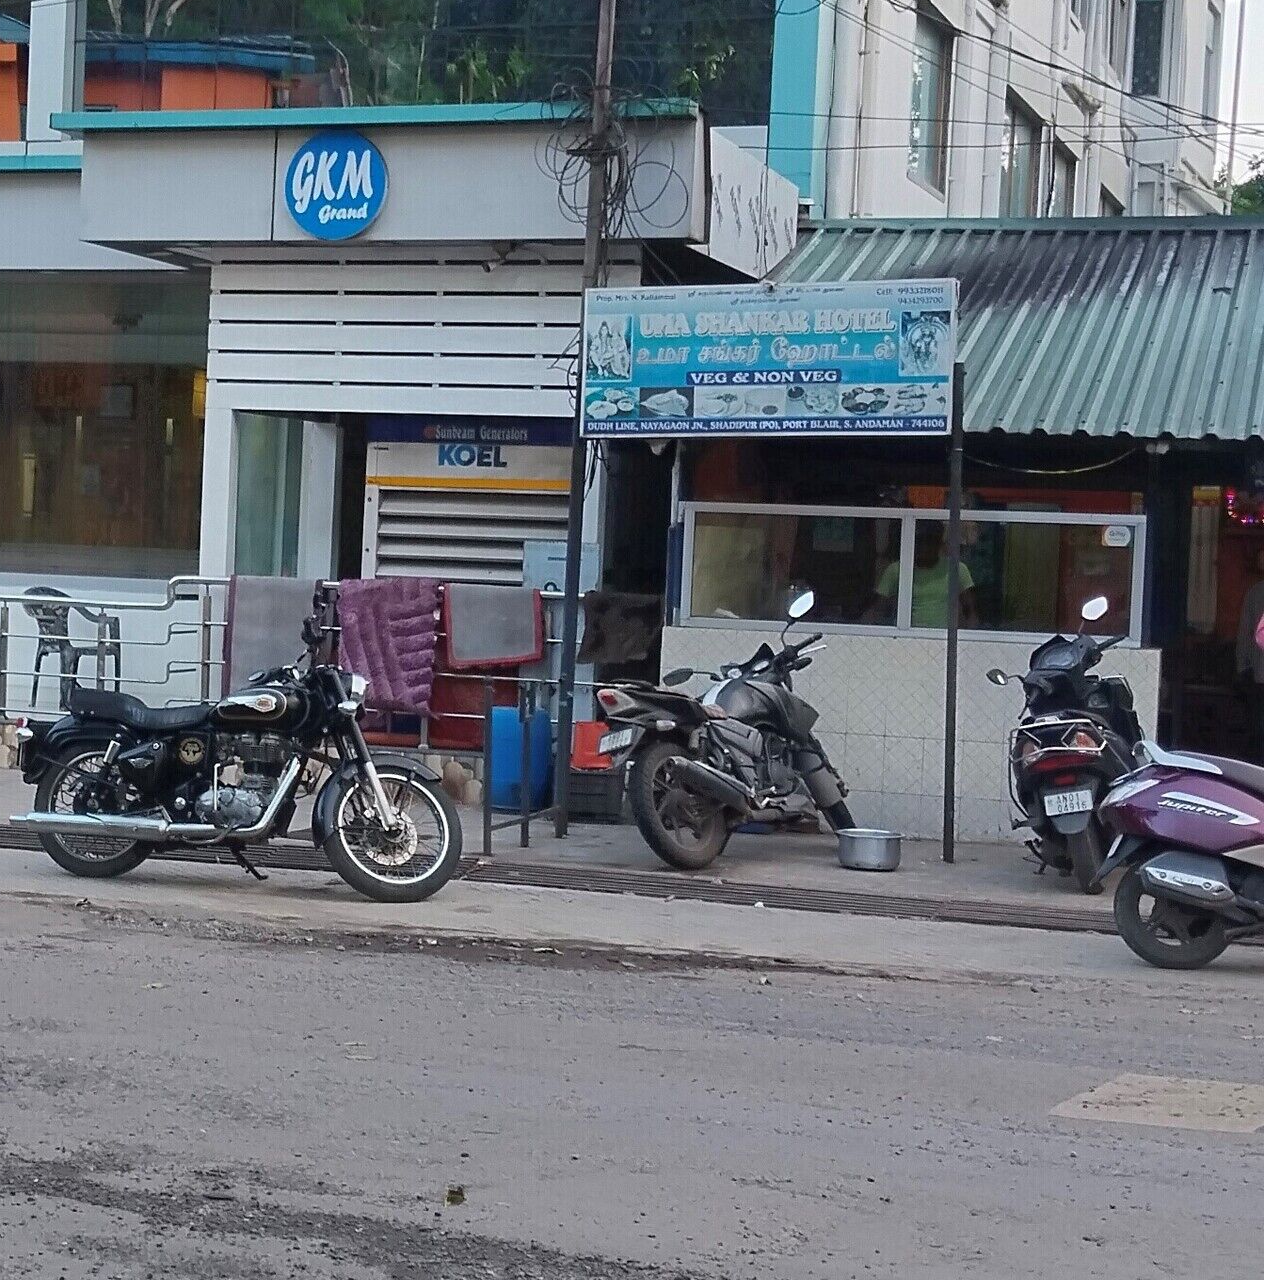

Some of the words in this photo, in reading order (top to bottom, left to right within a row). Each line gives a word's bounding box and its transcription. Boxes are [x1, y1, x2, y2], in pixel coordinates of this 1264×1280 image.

[292, 149, 373, 213] GKM
[318, 202, 368, 224] Grand
[640, 312, 691, 338] UMA
[694, 310, 810, 337] SHANKAR
[814, 308, 897, 334] HOTEL
[636, 344, 690, 365] உமா
[698, 337, 762, 367] சங்கர்
[690, 372, 727, 384] VEG
[732, 372, 750, 383] &
[754, 371, 795, 383] NON
[799, 370, 838, 382] VEG
[435, 424, 476, 440] Sunbeam
[480, 424, 529, 441] Generators
[641, 421, 689, 431] NAYAGAON
[710, 421, 758, 430] SHADIPUR
[783, 420, 809, 429] PORT
[810, 420, 842, 430] BLAIR,
[844, 420, 853, 429] S.
[854, 419, 904, 429] ANDAMAN
[911, 419, 945, 428] 744106
[438, 444, 508, 468] KOEL
